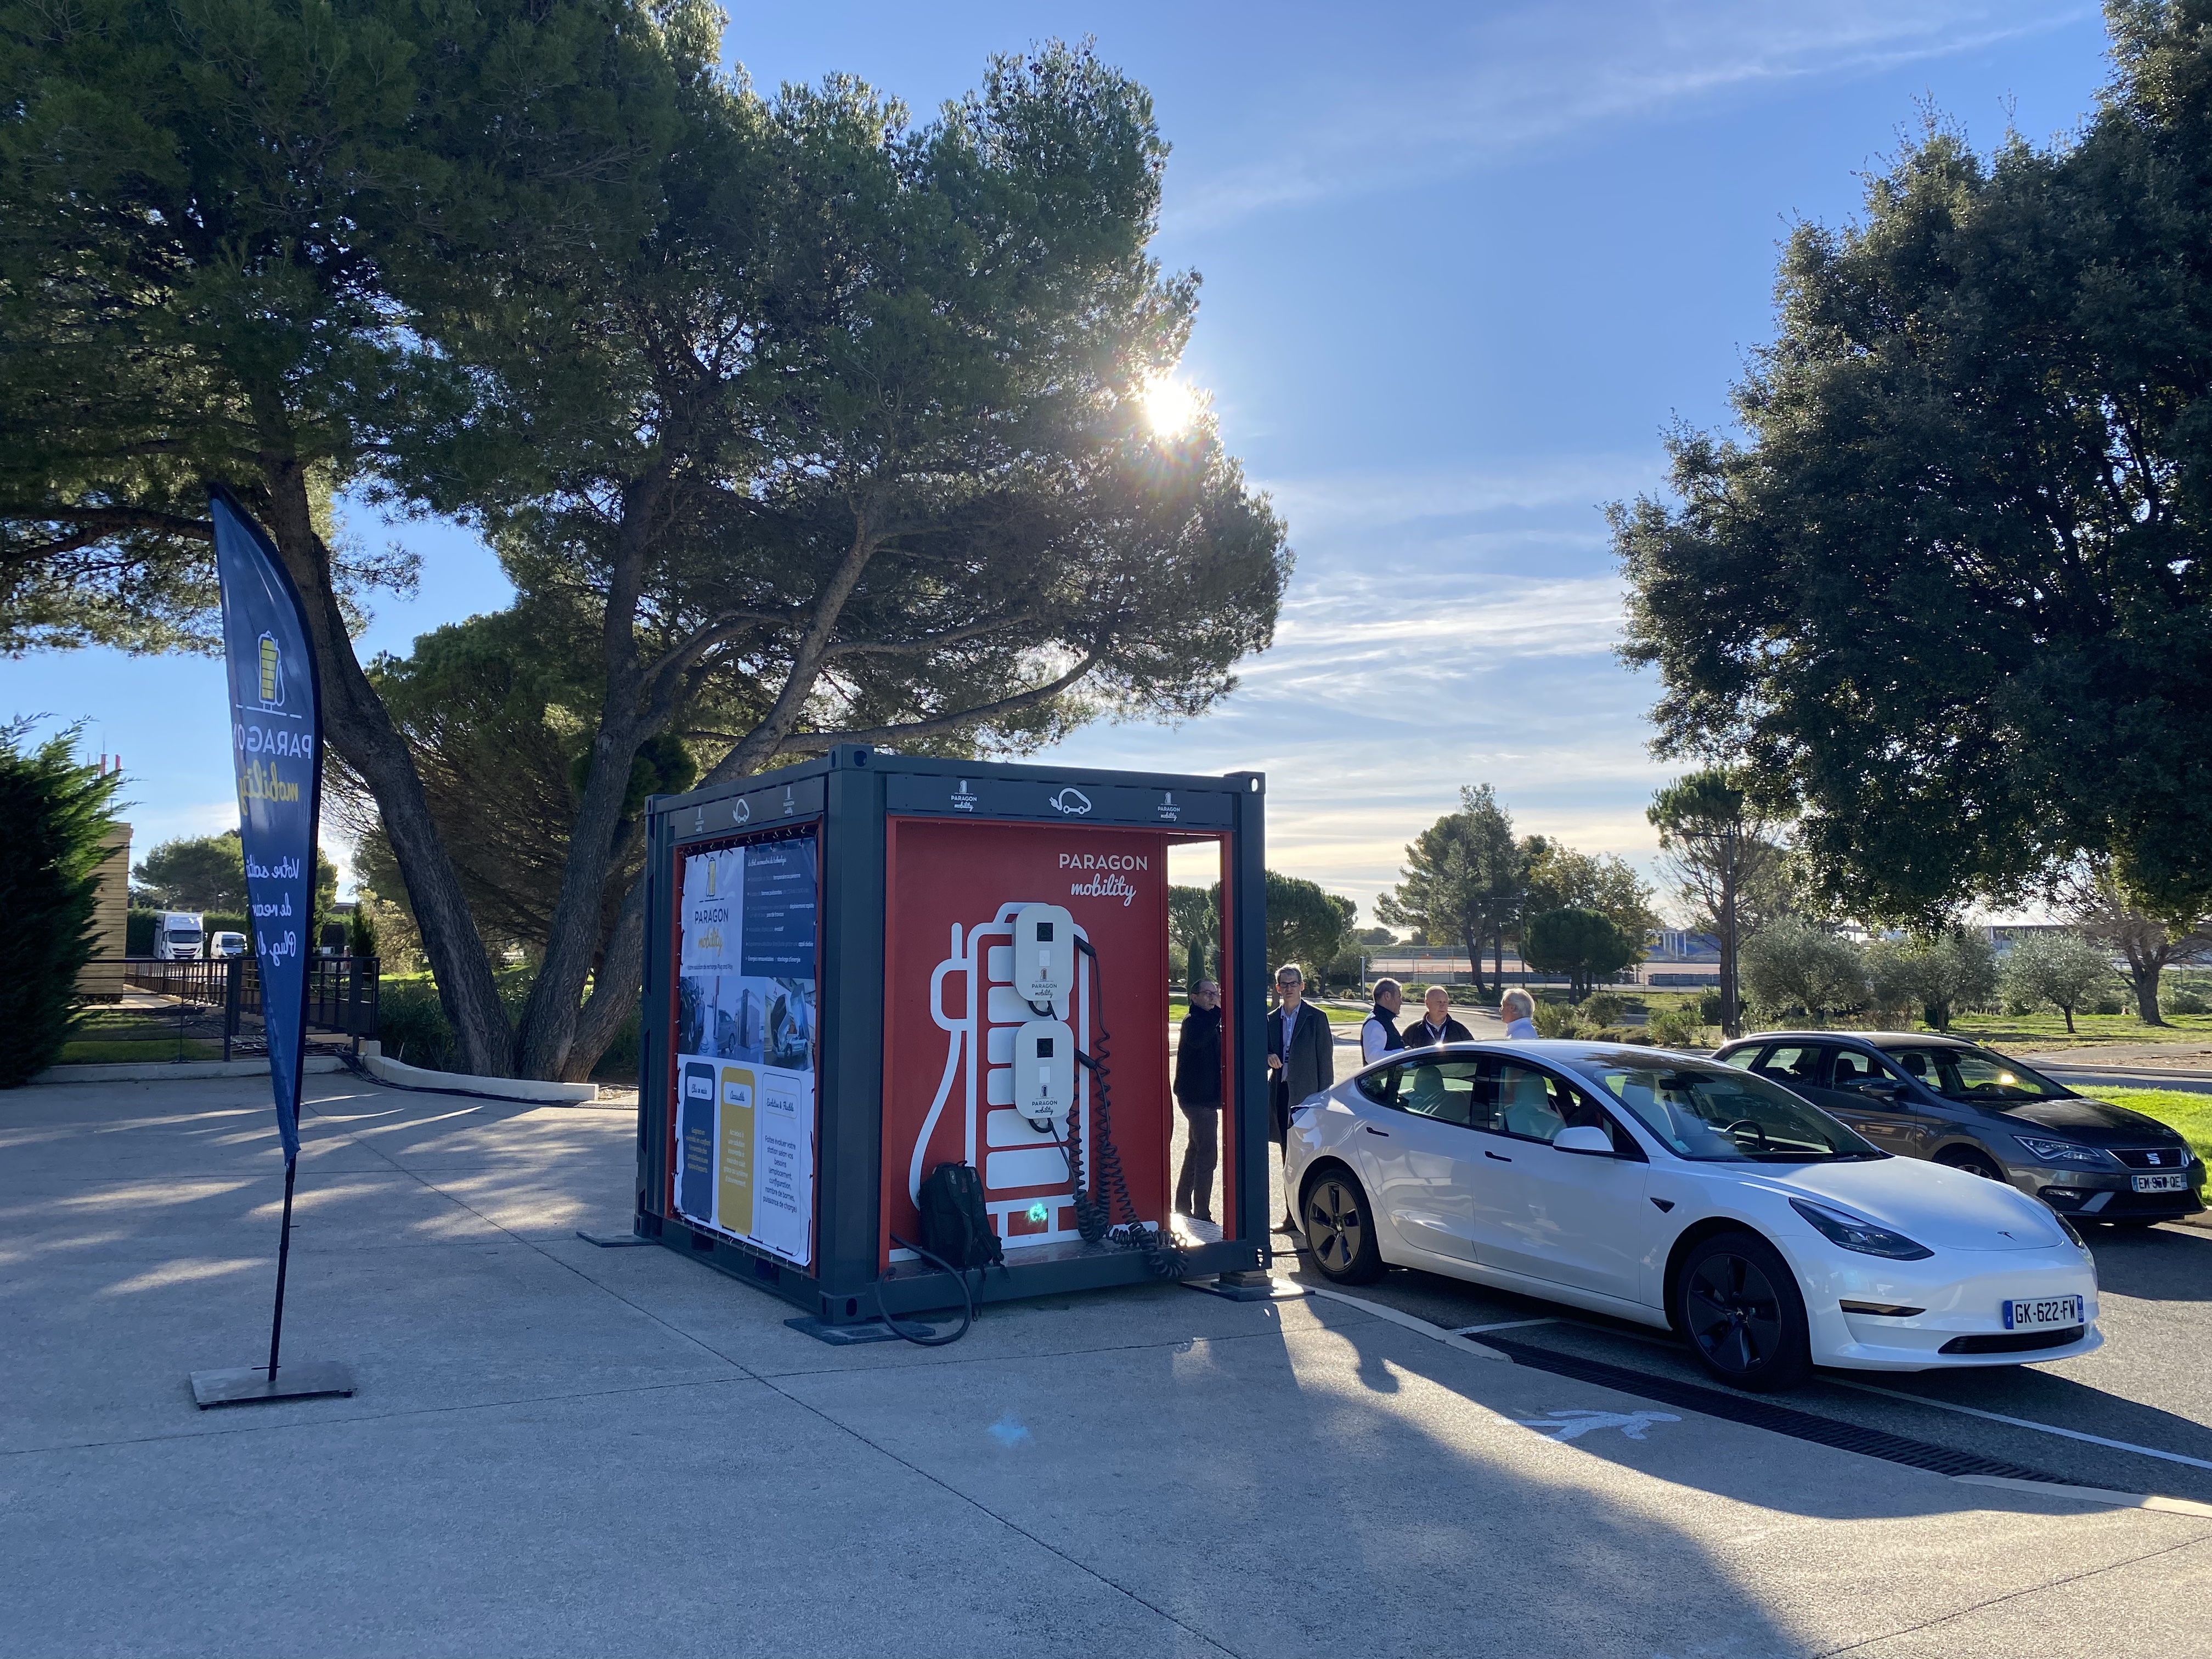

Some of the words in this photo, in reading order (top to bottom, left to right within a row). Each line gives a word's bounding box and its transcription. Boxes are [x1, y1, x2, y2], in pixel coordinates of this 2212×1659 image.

[954, 801, 974, 812] mobility
[1160, 811, 1177, 822] mobility
[1059, 853, 1148, 871] PARAGON
[1071, 873, 1137, 907] mobility
[695, 907, 729, 924] PARAGON
[698, 927, 723, 958] mobility
[1035, 989, 1054, 998] mobility
[1035, 1106, 1053, 1116] mobility
[765, 1135, 774, 1144] Faites
[787, 1141, 795, 1150] votre
[767, 1146, 778, 1155] station
[778, 1149, 787, 1158] selon
[774, 1158, 787, 1168] besoins
[765, 1186, 777, 1196] nombre
[763, 1195, 778, 1207] puissance
[779, 1200, 783, 1208] de
[783, 1202, 797, 1213] charge)
[2016, 1300, 2075, 1324] GK-622-FW
